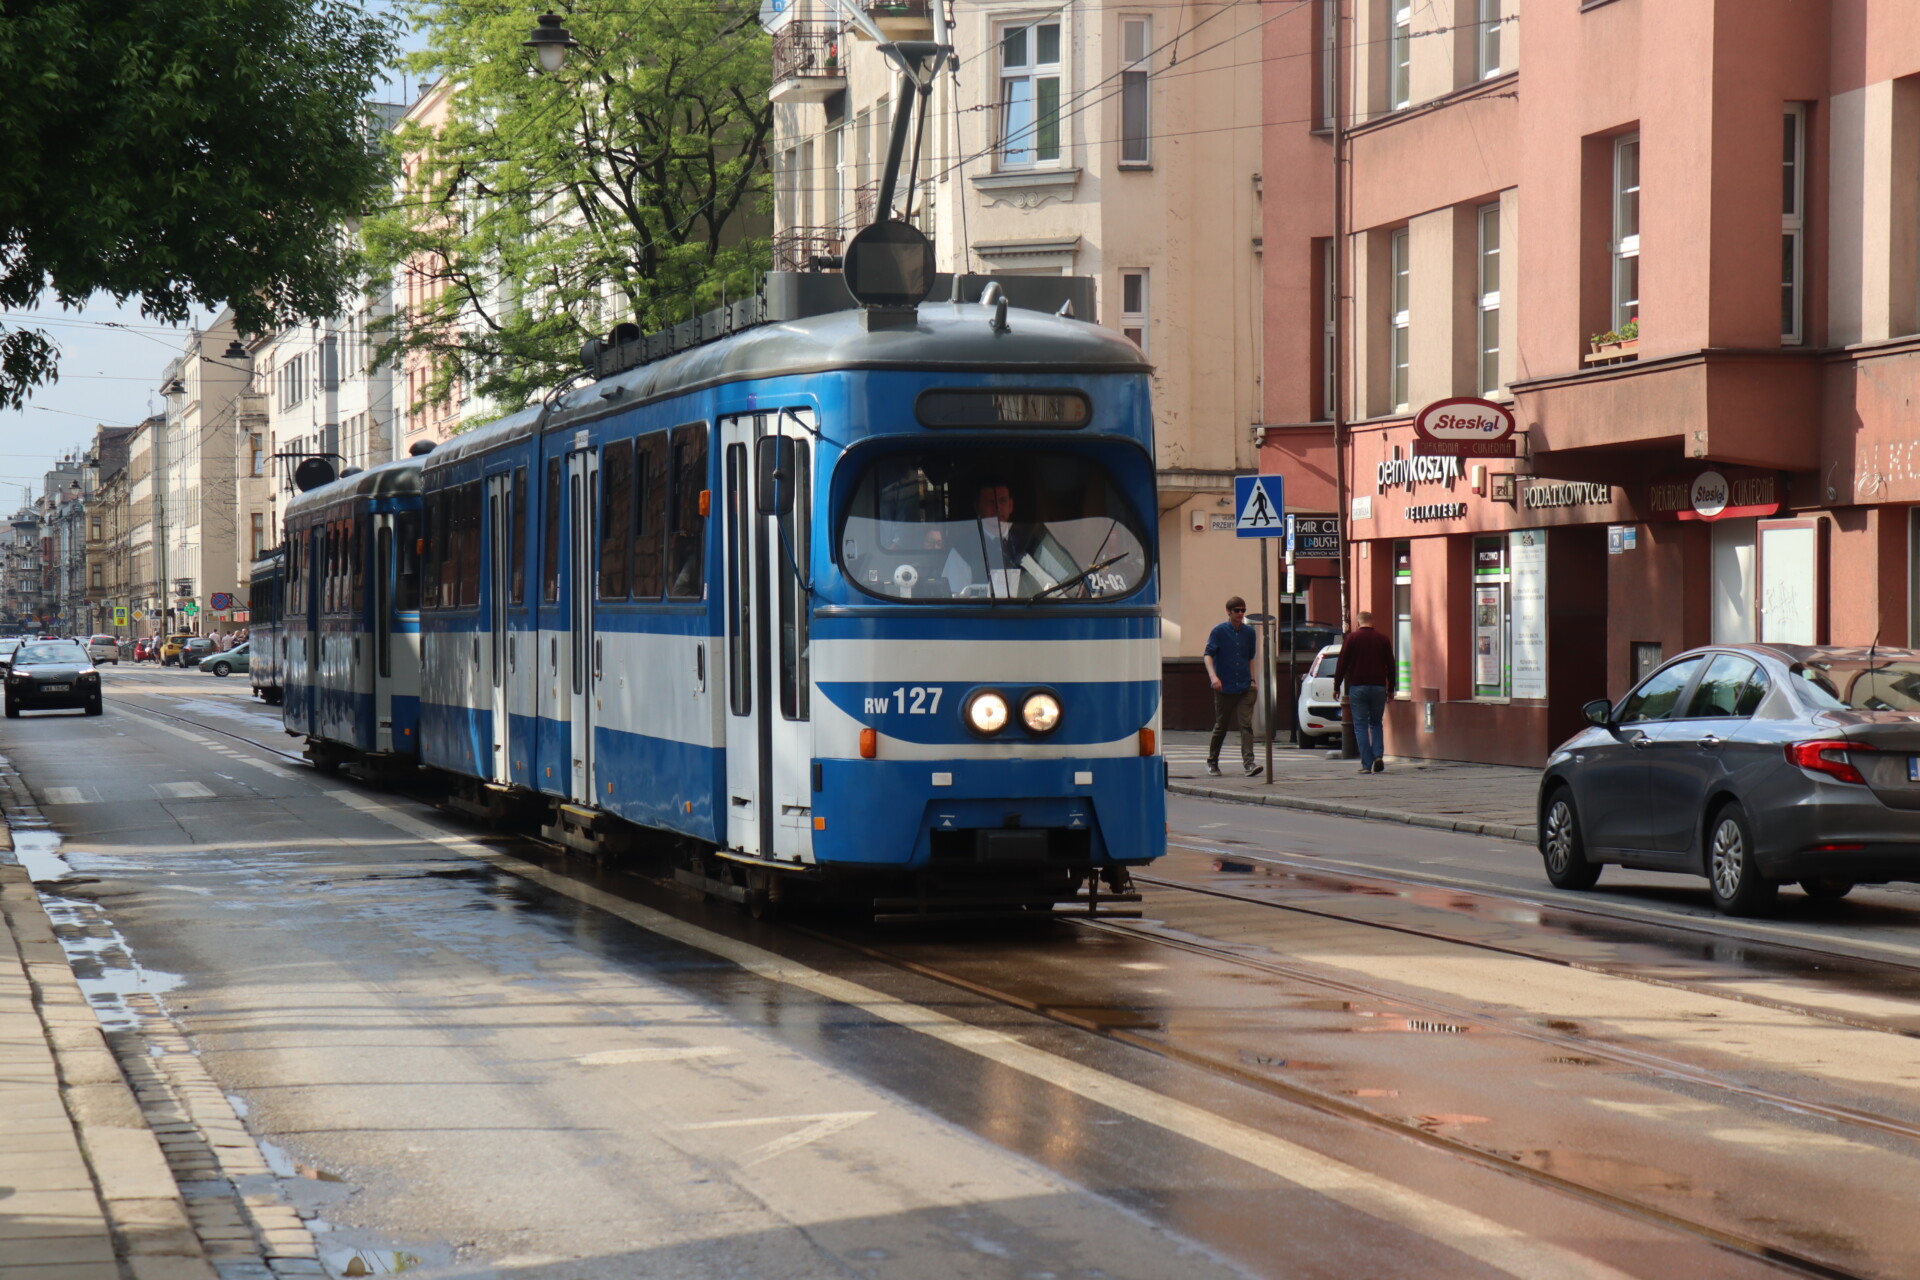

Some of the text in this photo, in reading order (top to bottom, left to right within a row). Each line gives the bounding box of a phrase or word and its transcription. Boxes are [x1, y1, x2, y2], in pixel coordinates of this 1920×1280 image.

[1433, 414, 1500, 433] Steskal
[1472, 442, 1511, 455] CUKIERNIA
[1523, 482, 1608, 508] PODATKOWYCH
[1650, 483, 1689, 511] PIEKARNIA
[1694, 485, 1725, 504] Steskal
[1732, 477, 1774, 506] CUKIERNIA
[1404, 502, 1460, 520] DELIKATESY
[1088, 573, 1127, 591] 24-03
[864, 687, 943, 714] RW 127
